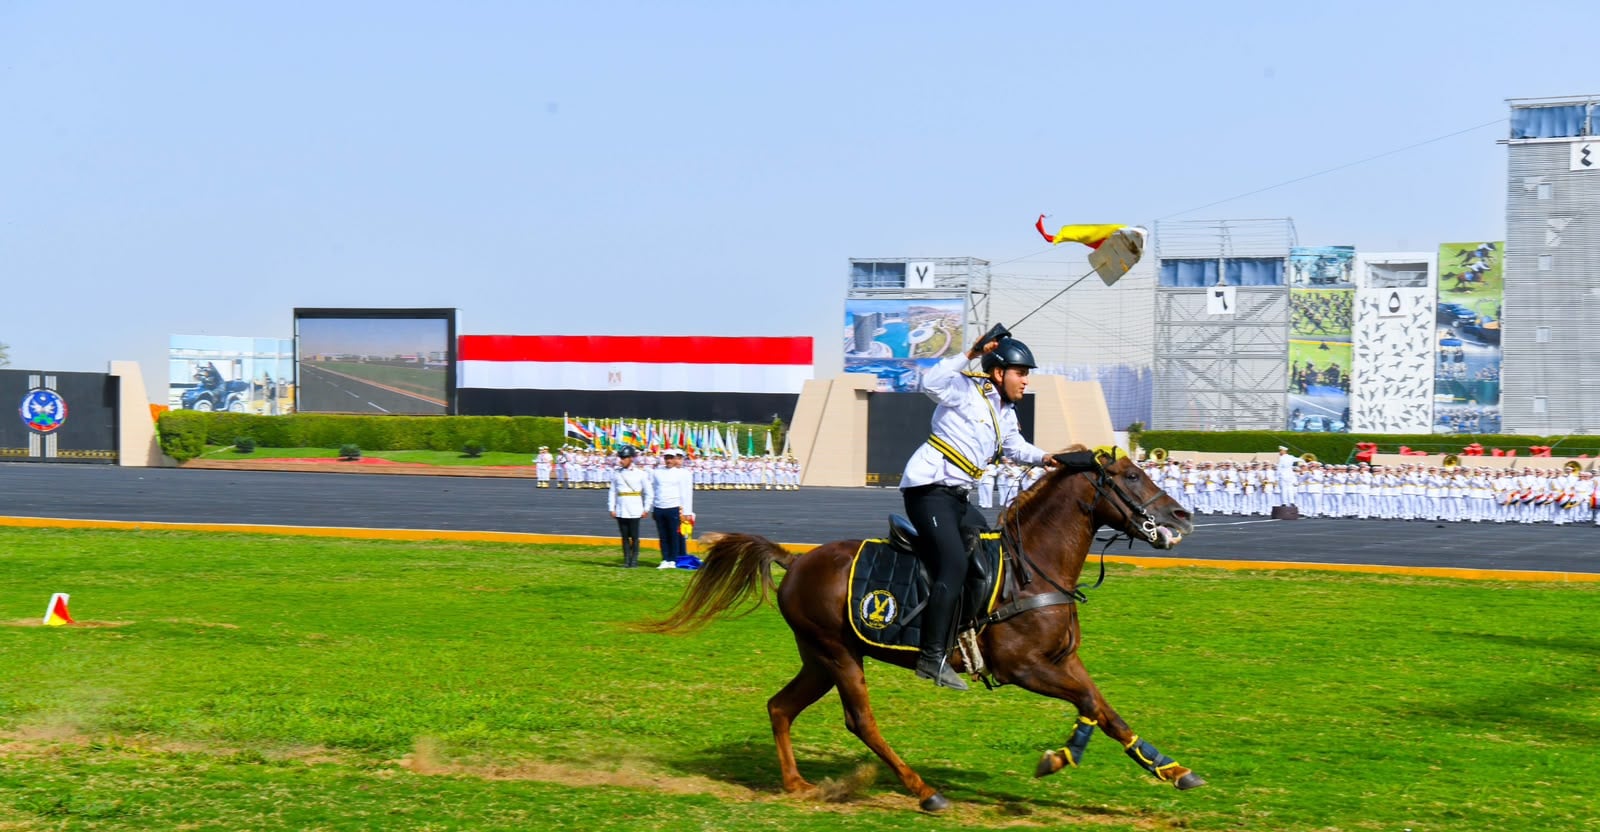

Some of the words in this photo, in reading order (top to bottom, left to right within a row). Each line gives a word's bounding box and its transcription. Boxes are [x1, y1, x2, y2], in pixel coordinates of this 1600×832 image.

[1581, 144, 1593, 167] ٤
[916, 265, 928, 284] ٧
[1215, 291, 1228, 311] ٦
[1389, 291, 1401, 313] ٥
